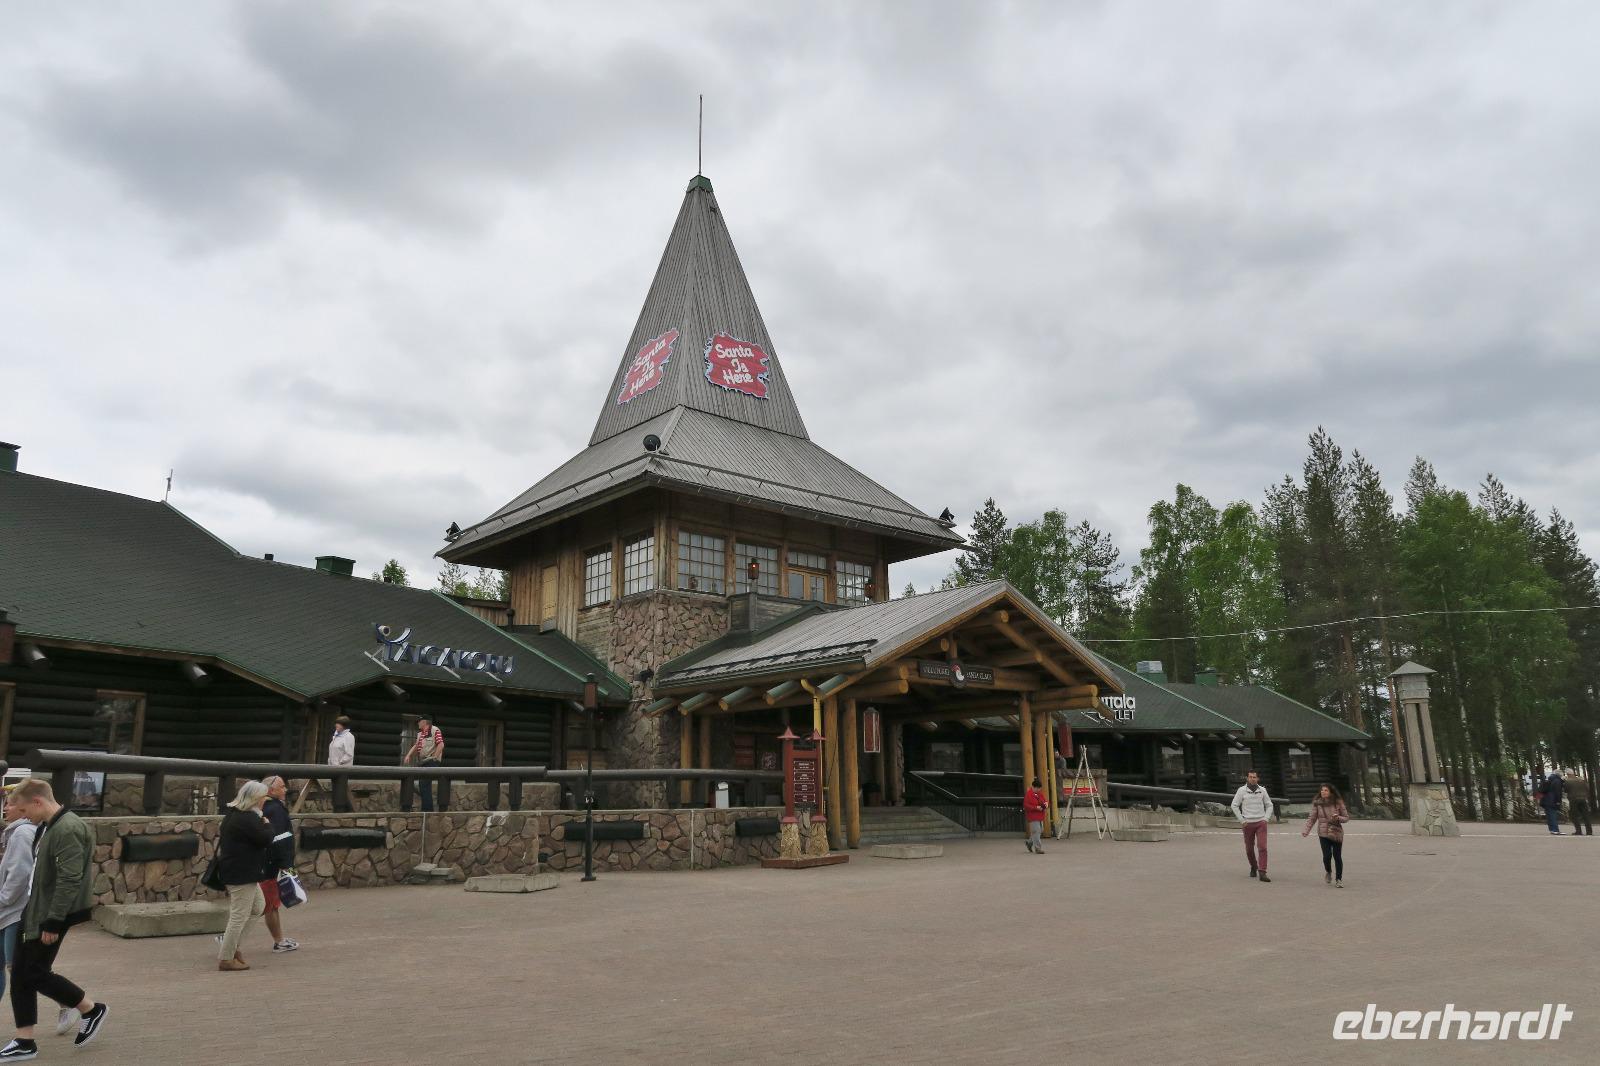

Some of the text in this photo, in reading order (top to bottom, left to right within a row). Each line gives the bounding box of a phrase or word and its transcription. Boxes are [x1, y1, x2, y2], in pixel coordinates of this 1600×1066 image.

[634, 338, 666, 372] Santa
[715, 344, 755, 359] Santa
[731, 358, 749, 373] Is
[630, 369, 655, 395] Here
[723, 369, 753, 385] Here
